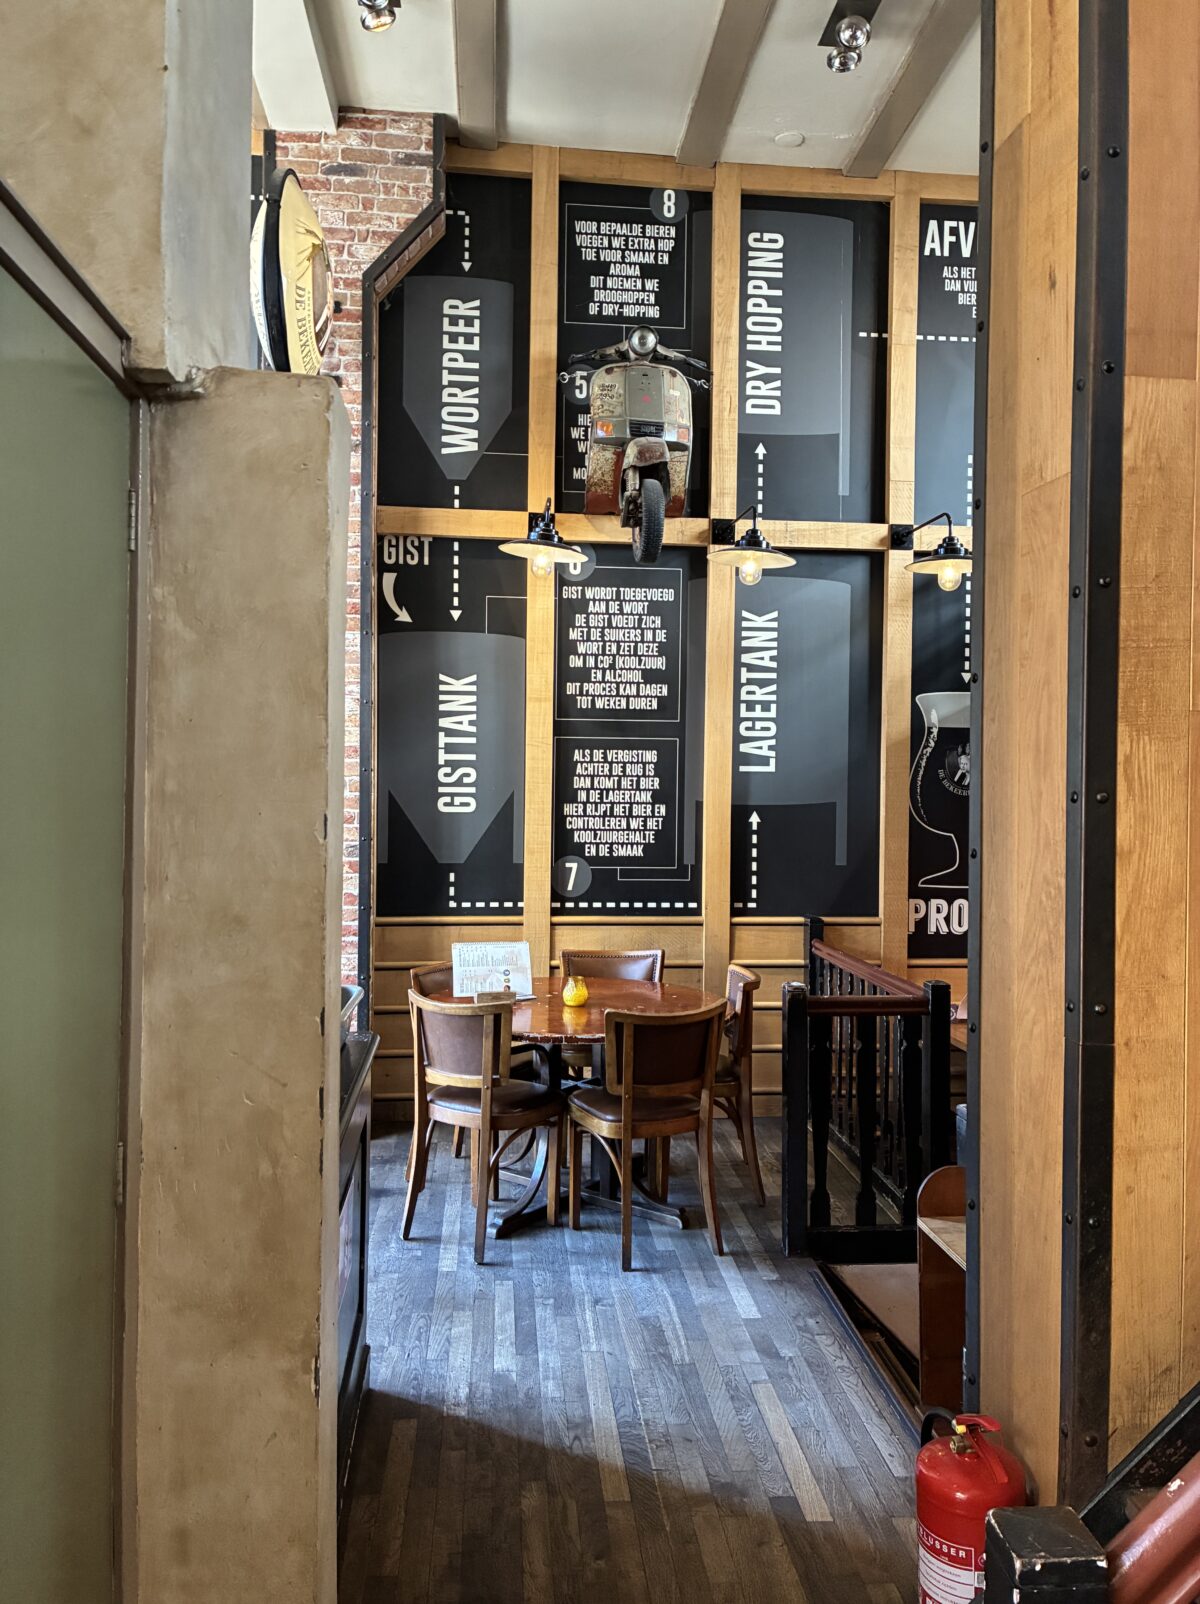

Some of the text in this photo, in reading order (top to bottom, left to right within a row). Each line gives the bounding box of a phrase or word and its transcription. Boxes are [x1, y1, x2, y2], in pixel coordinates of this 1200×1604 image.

[663, 189, 675, 218] 8
[575, 220, 675, 238] VOOR BEPAALDE BIEREN
[576, 234, 675, 251] VOEGEN WE EXTRA HOP
[581, 248, 668, 264] TOE VOOR SMAAK EN
[609, 263, 640, 276] AROMA
[943, 266, 976, 279] ALS HET
[590, 276, 659, 291] DIT NOEMEN WE
[944, 279, 961, 291] DAN
[295, 285, 306, 311] DE
[594, 290, 655, 304] DROOGHOPPEN
[958, 293, 976, 305] BIER
[589, 303, 659, 318] OF DRY-HOPPING
[745, 232, 784, 416] DRY HOPPING
[441, 299, 481, 455] WORTPEER
[575, 371, 587, 399] 5
[571, 427, 585, 439] WE
[383, 535, 433, 566] GIST
[562, 586, 675, 601] GIST WORDT TOEGEVOEGD
[588, 602, 648, 614] AAN DE WORT
[576, 615, 661, 628] DE GIST VOEDT ZICH
[569, 628, 667, 642] MET DE SUIKERS IN DE
[577, 642, 659, 655] WORT EN ZET DEZE
[569, 656, 583, 667] OM
[586, 656, 594, 668] IN
[616, 656, 666, 670] (KOOLZUUR)
[591, 670, 644, 682] EN ALCOHOL
[567, 683, 668, 696] DIT PROCES KAN DAGEN
[739, 610, 778, 772] LAGERTANK
[576, 697, 657, 710] TOT WEKEN DUREN
[437, 673, 478, 813] GISTTANK
[573, 749, 658, 763] ALS DE VERGISTING
[576, 763, 655, 775] ACHTER DE RUG IS
[574, 777, 659, 790] DAN KOMT HET BIER
[578, 790, 652, 803] IN DE LAGERTANK
[564, 804, 666, 817] HIER RIJPT HET BIER EN
[566, 817, 663, 830] CONTROLEREN WE HET
[574, 831, 655, 843] KOOLZUURGEHALTE
[585, 844, 644, 857] EN DE SMAAK
[565, 863, 578, 891] 7
